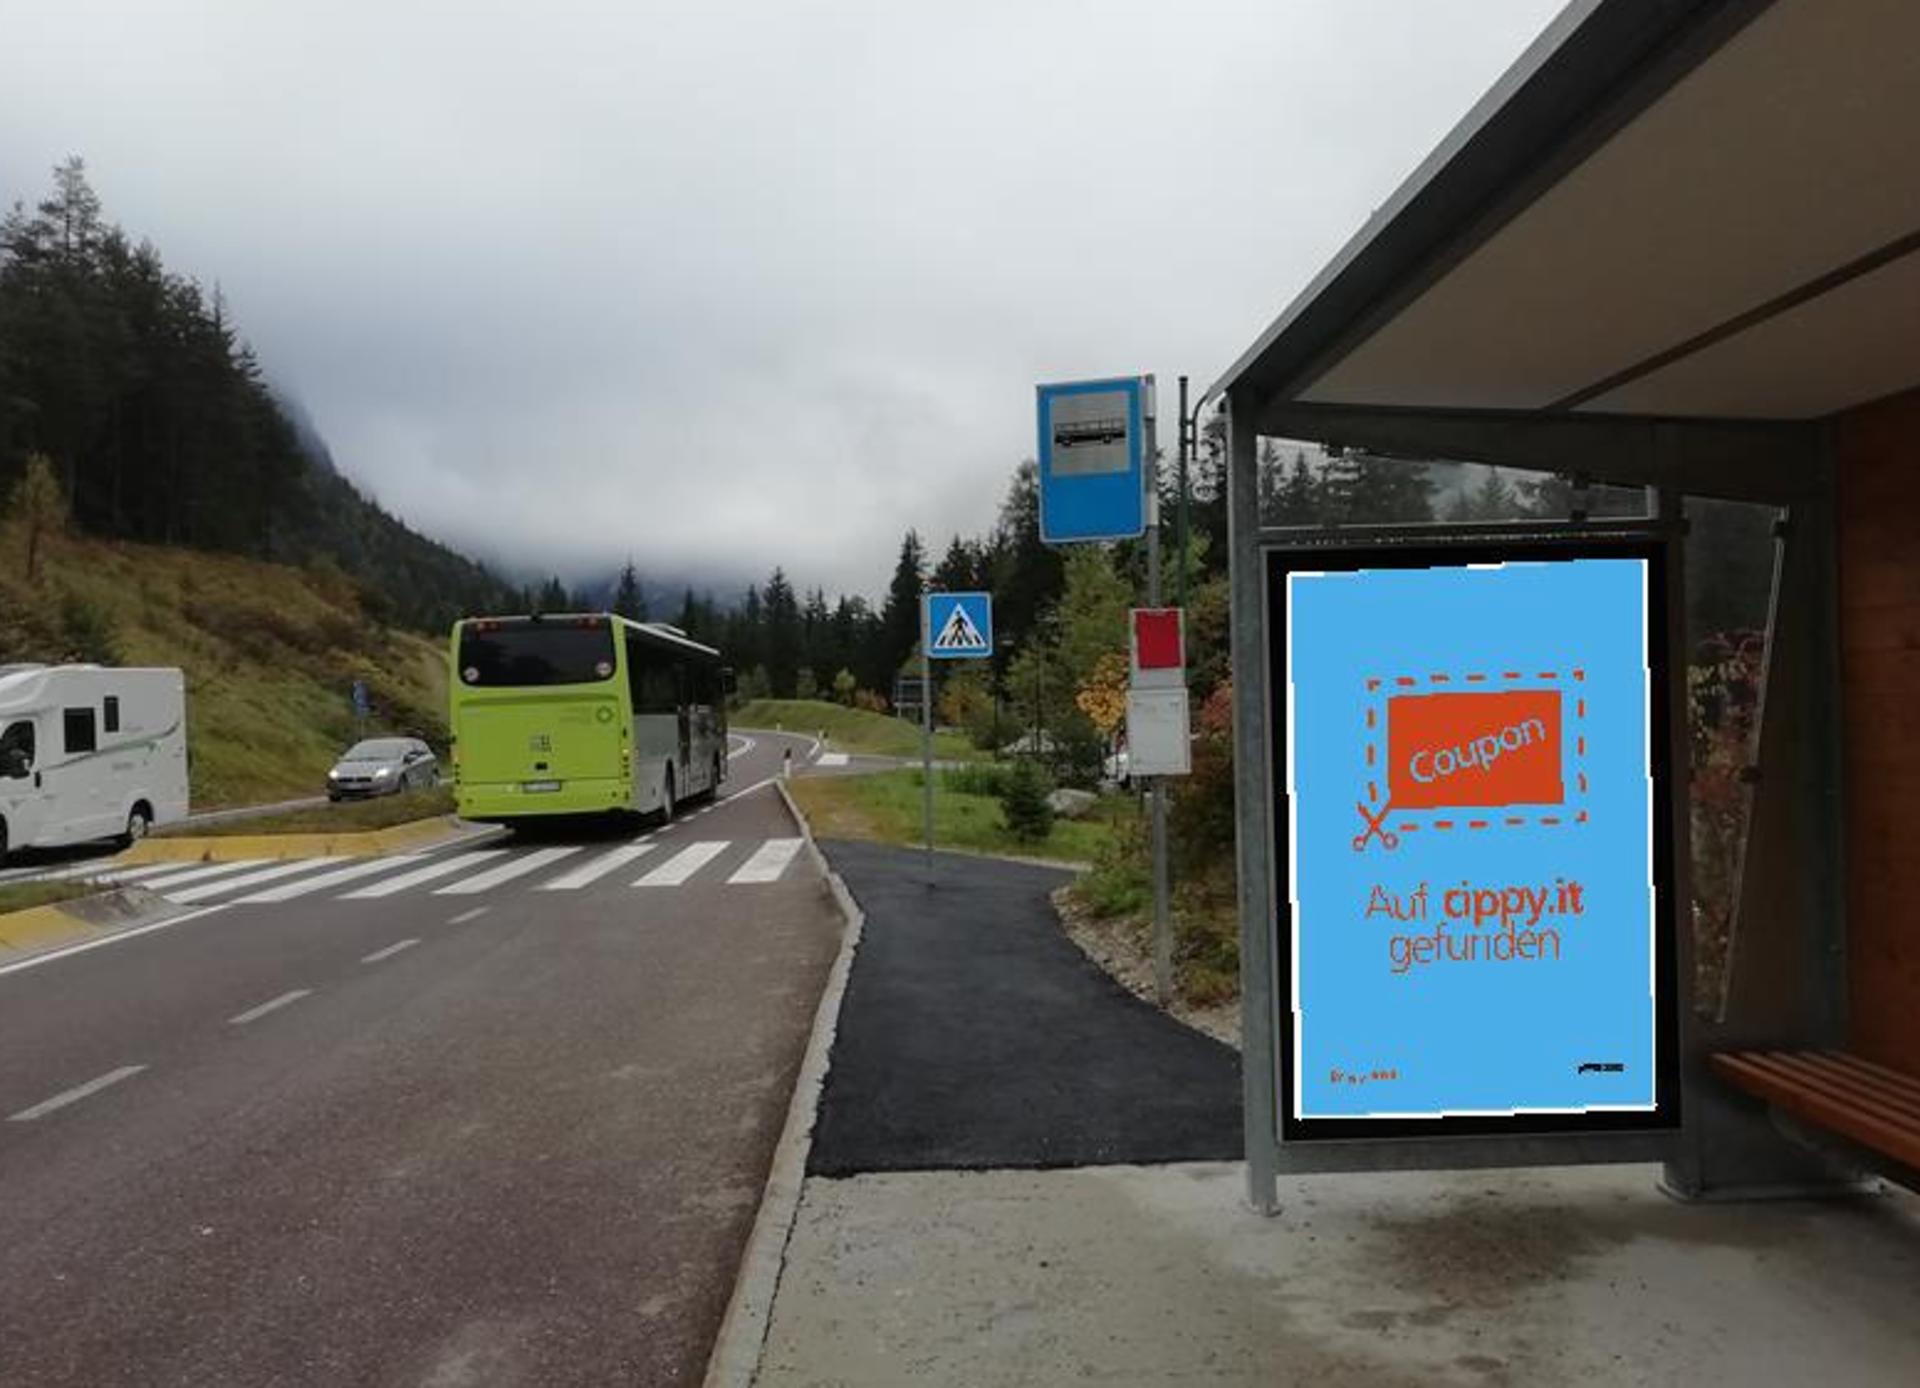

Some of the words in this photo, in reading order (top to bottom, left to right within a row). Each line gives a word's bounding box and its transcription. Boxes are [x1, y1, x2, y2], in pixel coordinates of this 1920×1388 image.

[1409, 718, 1546, 783] Coupon
[1365, 881, 1429, 920] Auf
[1443, 878, 1585, 928] cippy.it
[1389, 920, 1561, 974] gefunden
